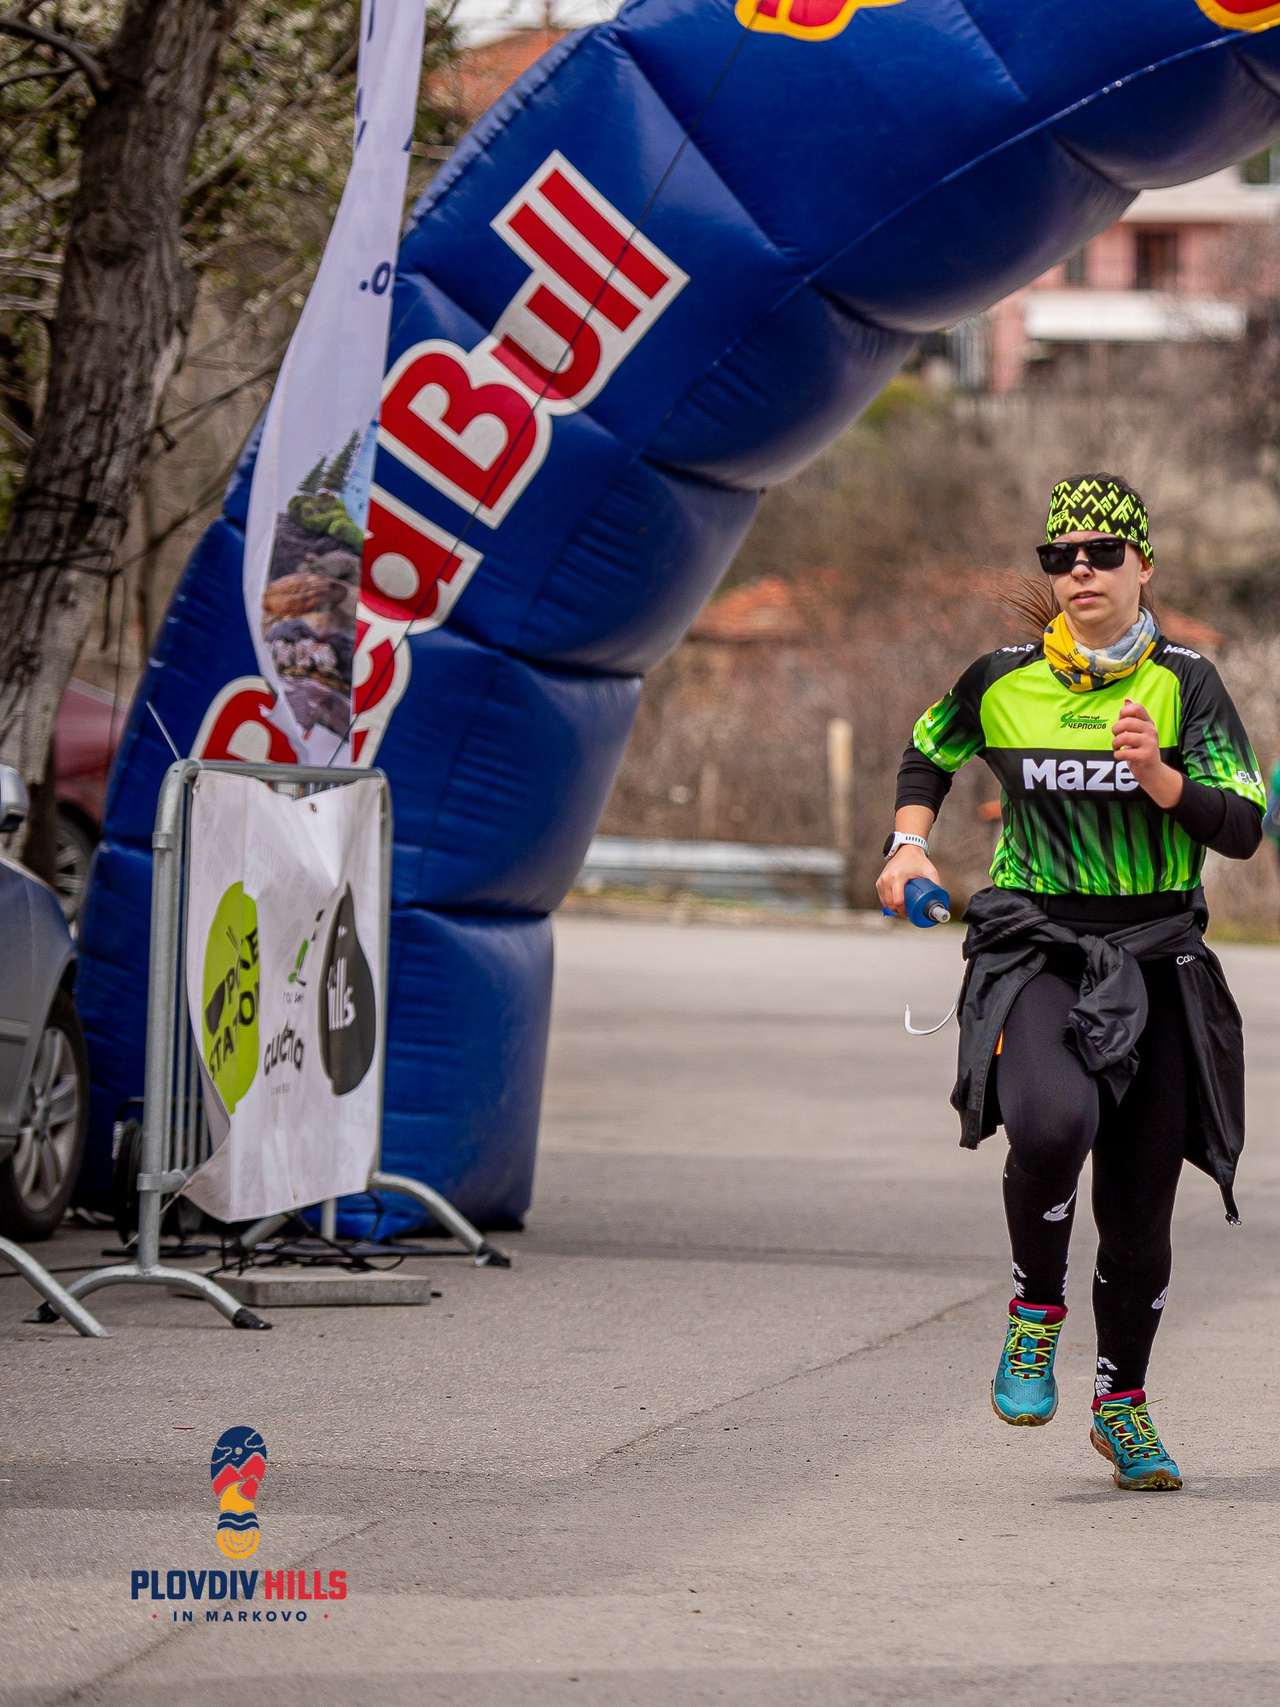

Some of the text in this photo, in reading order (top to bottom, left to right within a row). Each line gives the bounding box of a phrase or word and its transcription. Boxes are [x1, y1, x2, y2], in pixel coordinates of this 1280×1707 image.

[377, 158, 685, 522] Bull
[1068, 722, 1107, 730] ЧЕРПОКОВ
[1022, 758, 1140, 792] Maze
